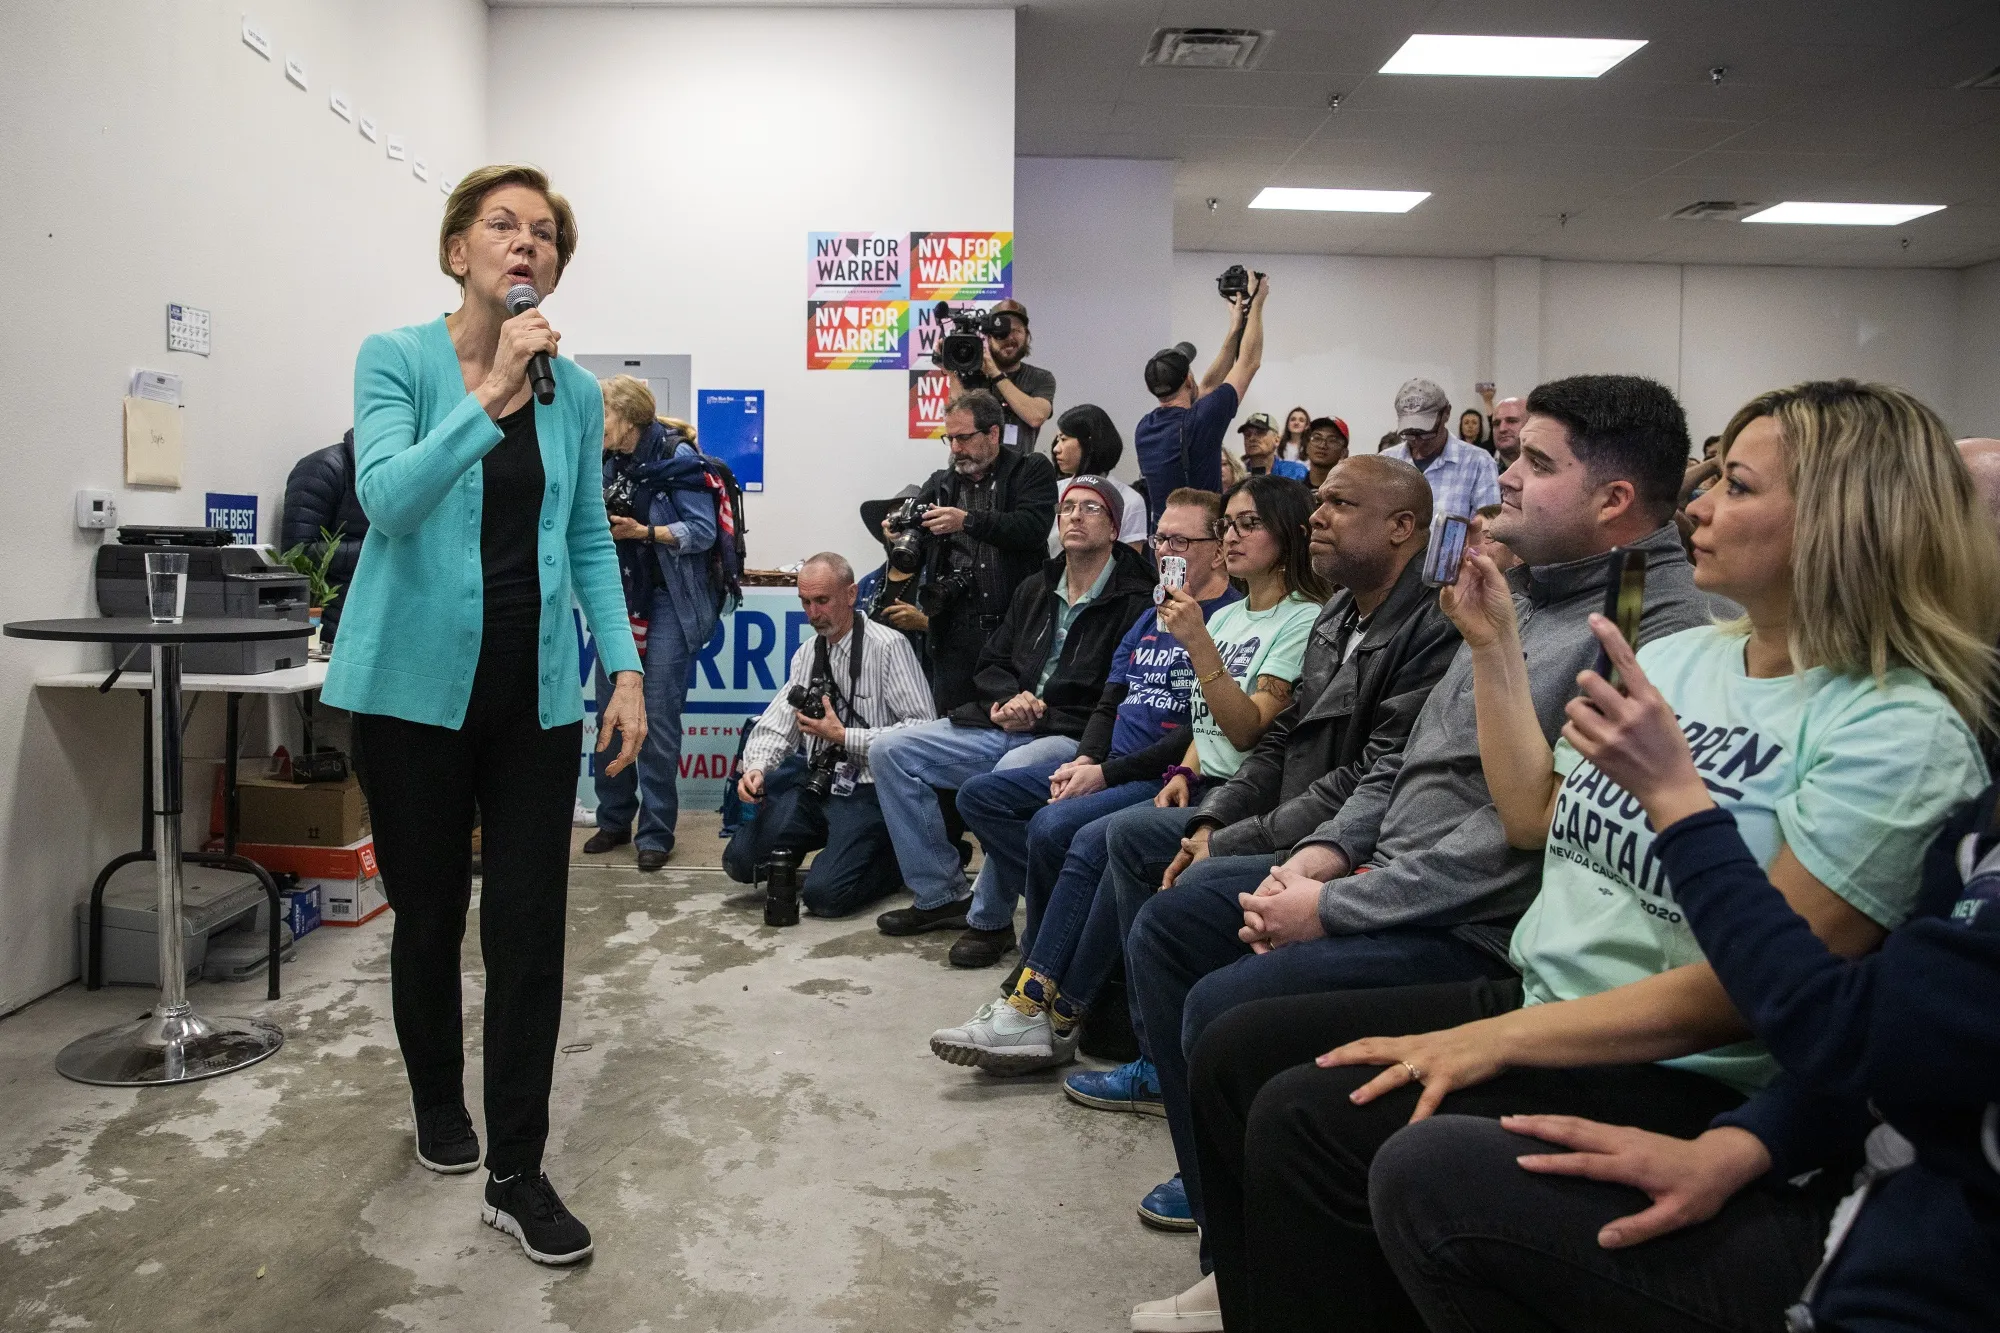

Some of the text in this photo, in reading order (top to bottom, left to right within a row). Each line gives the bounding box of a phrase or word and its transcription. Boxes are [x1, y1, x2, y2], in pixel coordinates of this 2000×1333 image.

[817, 239, 898, 257] NV FOR
[918, 237, 1002, 258] NV FOR
[816, 260, 898, 281] WARREN
[918, 259, 1002, 282] WARREN
[815, 306, 898, 327] NV FOR
[815, 327, 898, 351] WARREN
[917, 376, 945, 396] NV
[209, 508, 255, 530] THE BEST
[1143, 672, 1167, 685] 2020
[1170, 668, 1194, 678] NEVADA
[1549, 843, 1590, 870] NEVADA
[1639, 898, 1682, 924] 2020
